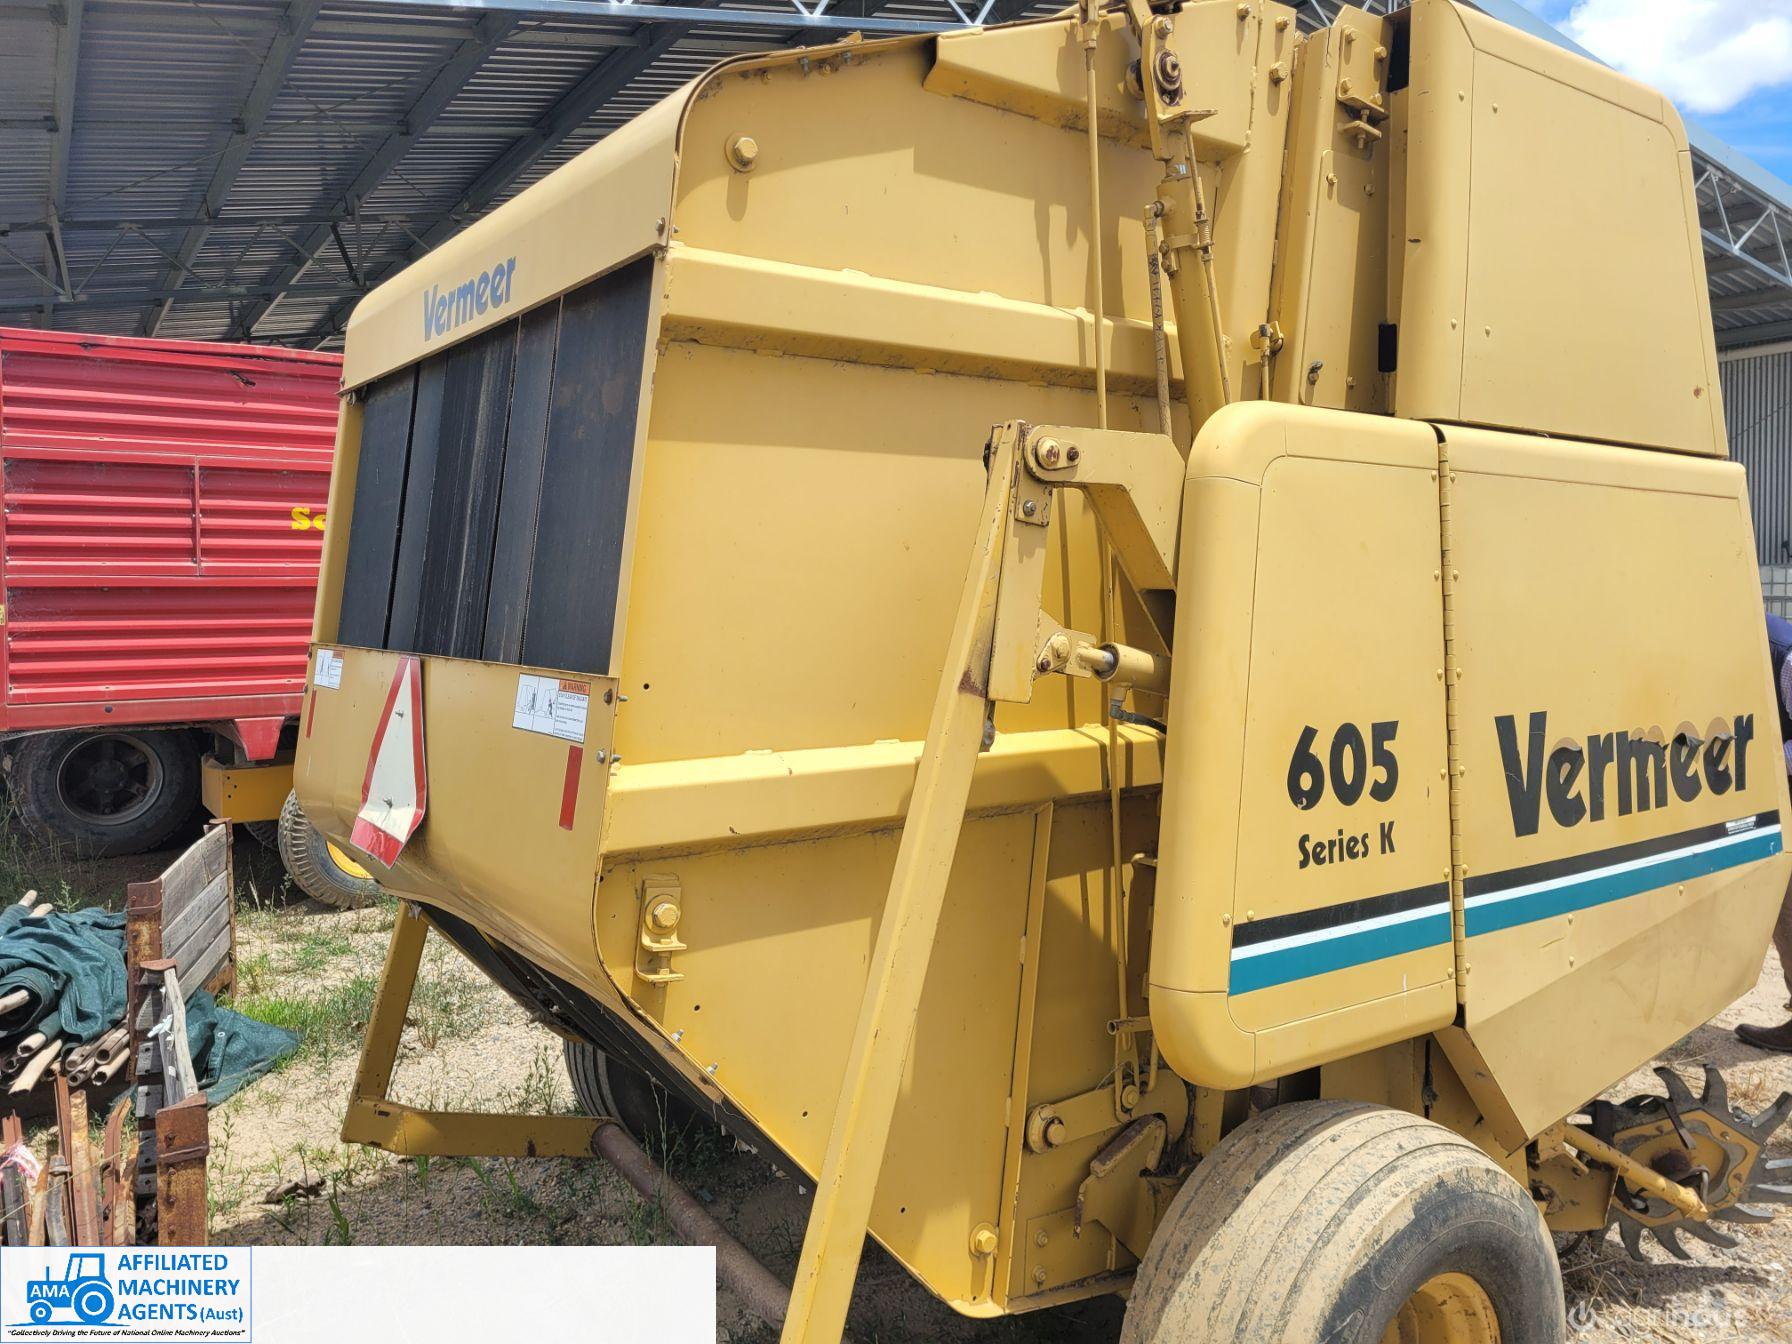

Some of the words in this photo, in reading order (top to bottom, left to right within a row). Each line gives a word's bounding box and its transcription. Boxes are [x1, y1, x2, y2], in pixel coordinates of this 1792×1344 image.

[424, 256, 516, 342] Vermeer
[1287, 720, 1399, 811] 605
[1494, 711, 1754, 838] Vermeer
[1298, 829, 1369, 869] Series
[1380, 821, 1396, 854] K
